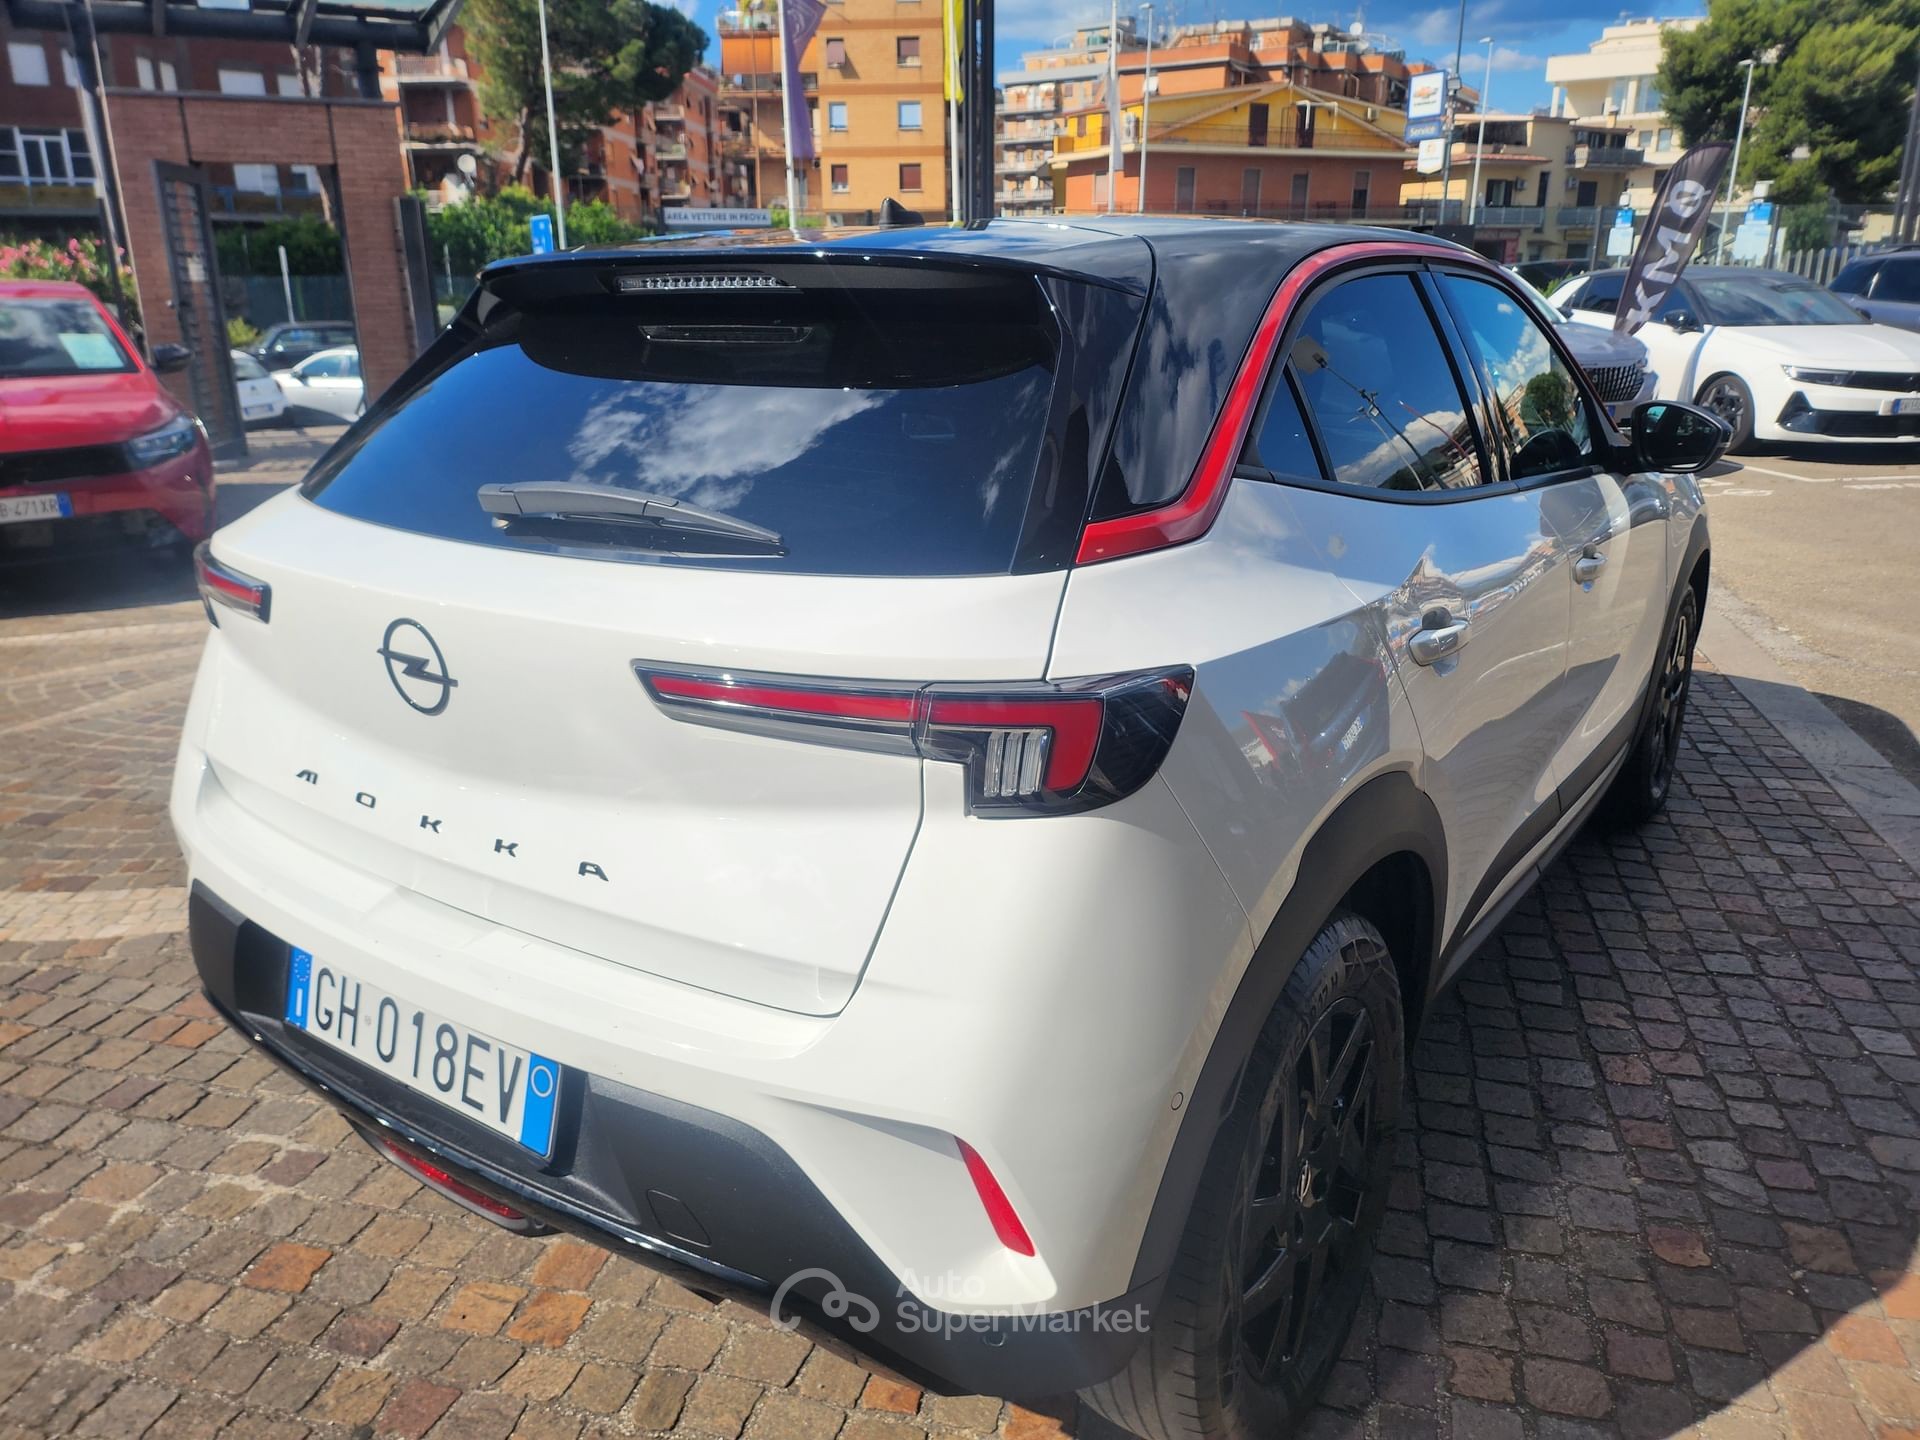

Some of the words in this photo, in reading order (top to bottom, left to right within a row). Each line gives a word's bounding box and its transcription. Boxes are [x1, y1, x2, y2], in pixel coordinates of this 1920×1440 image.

[667, 211, 688, 221] AREA
[740, 211, 768, 221] PROVA
[296, 769, 609, 882] MOKKA
